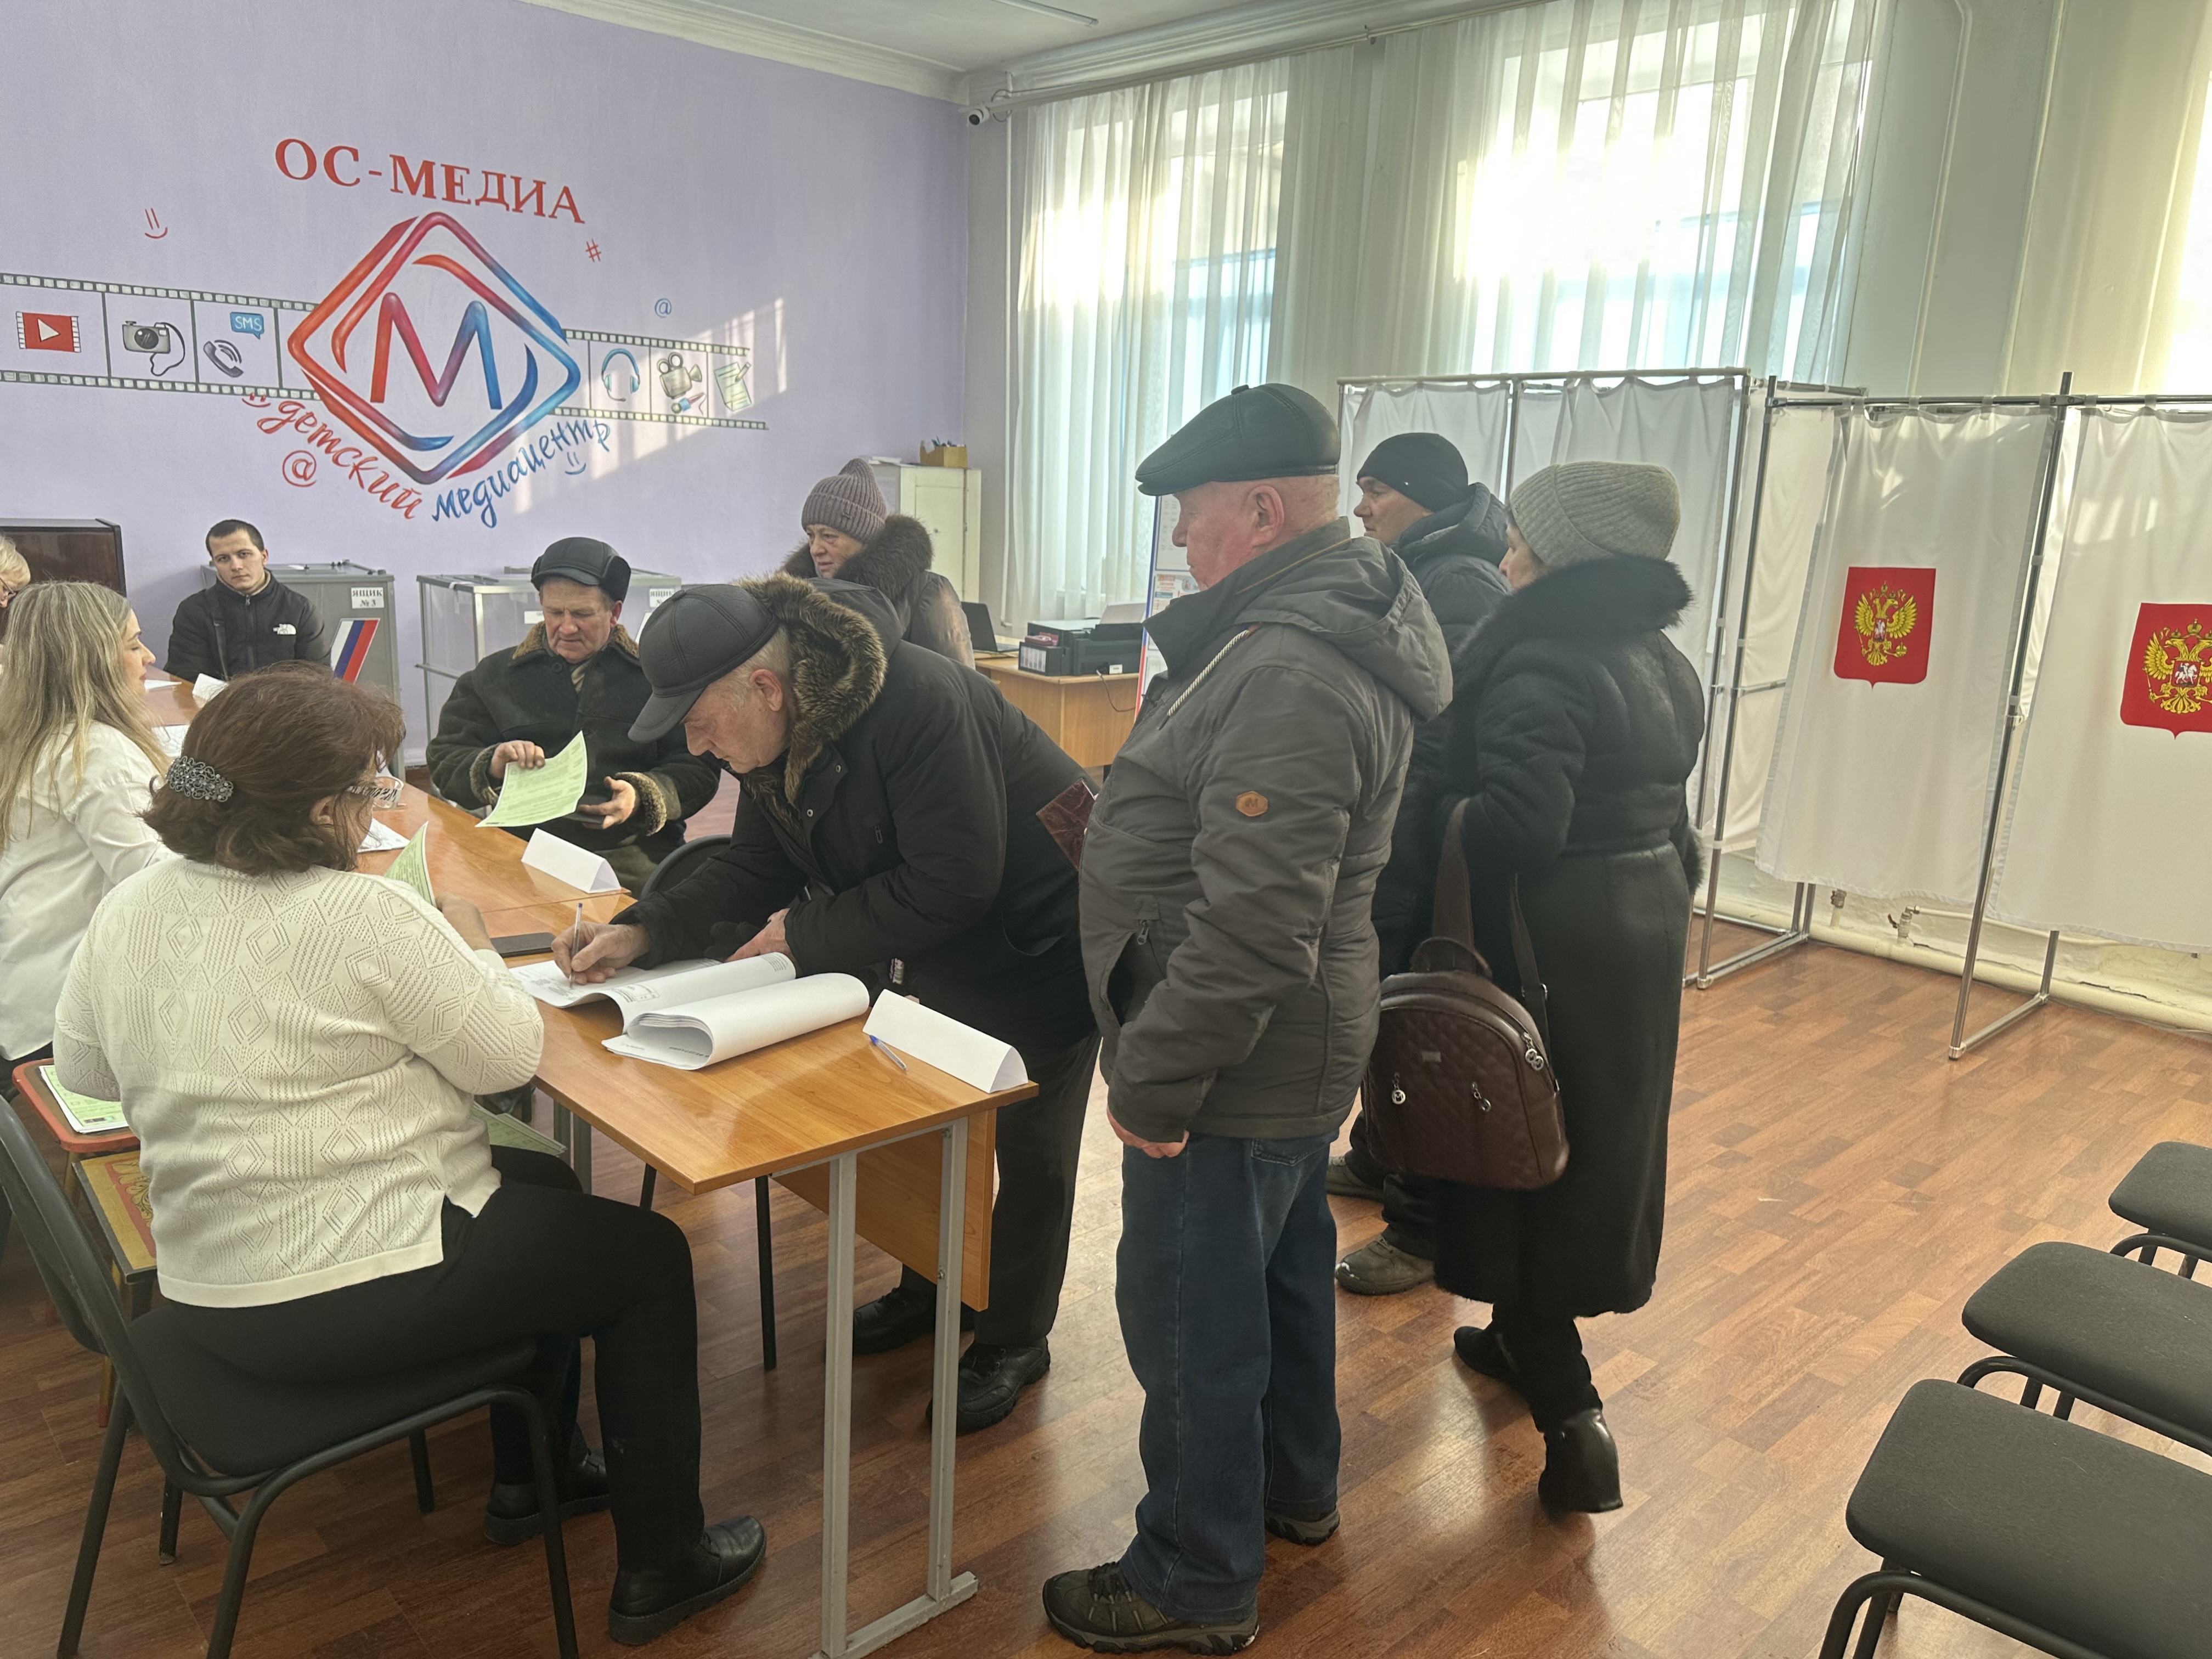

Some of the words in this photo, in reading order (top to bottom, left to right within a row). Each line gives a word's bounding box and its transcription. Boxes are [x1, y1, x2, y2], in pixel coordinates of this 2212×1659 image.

[275, 138, 585, 224] ОС-МЕДИА
[235, 315, 262, 332] SMS
[257, 400, 422, 519] детский
[431, 419, 611, 528] медиацентр
